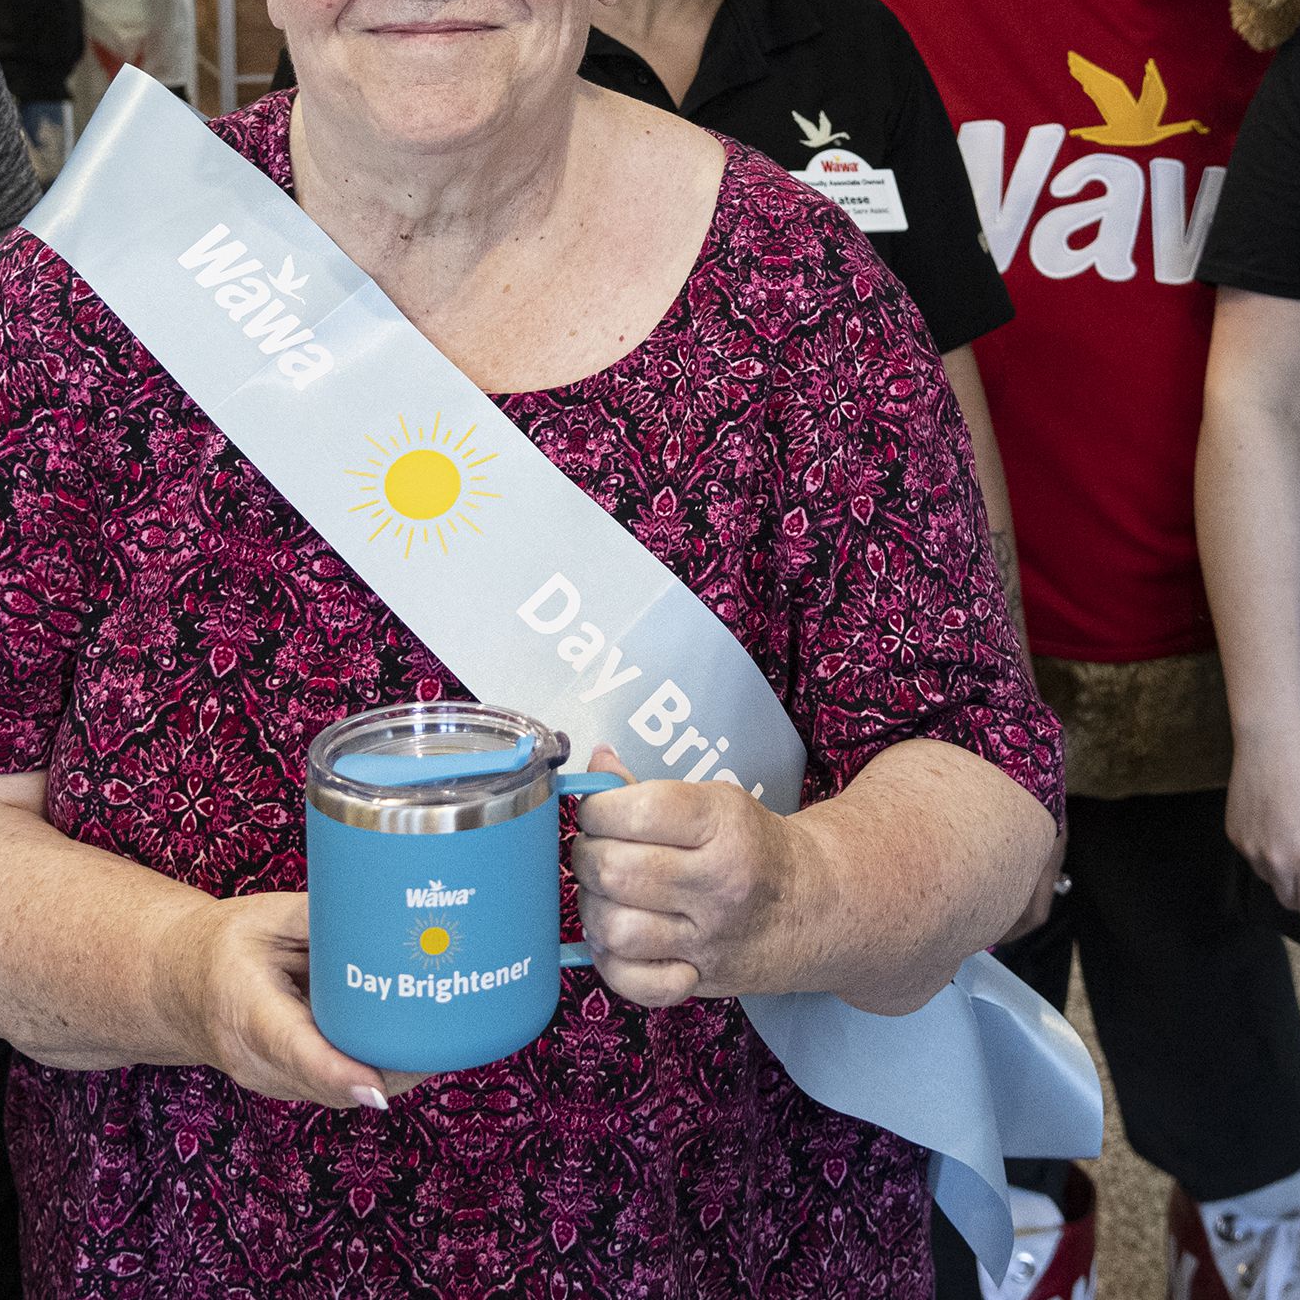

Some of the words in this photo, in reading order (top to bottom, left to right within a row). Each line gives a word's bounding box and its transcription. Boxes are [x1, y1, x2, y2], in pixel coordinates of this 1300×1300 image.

[820, 159, 859, 173] Wawa
[177, 222, 336, 391] Wawa
[516, 571, 643, 704] Day
[628, 679, 764, 802] Bri
[405, 886, 469, 908] Wawa
[346, 963, 392, 1000] Day
[398, 956, 532, 1004] Brightener
